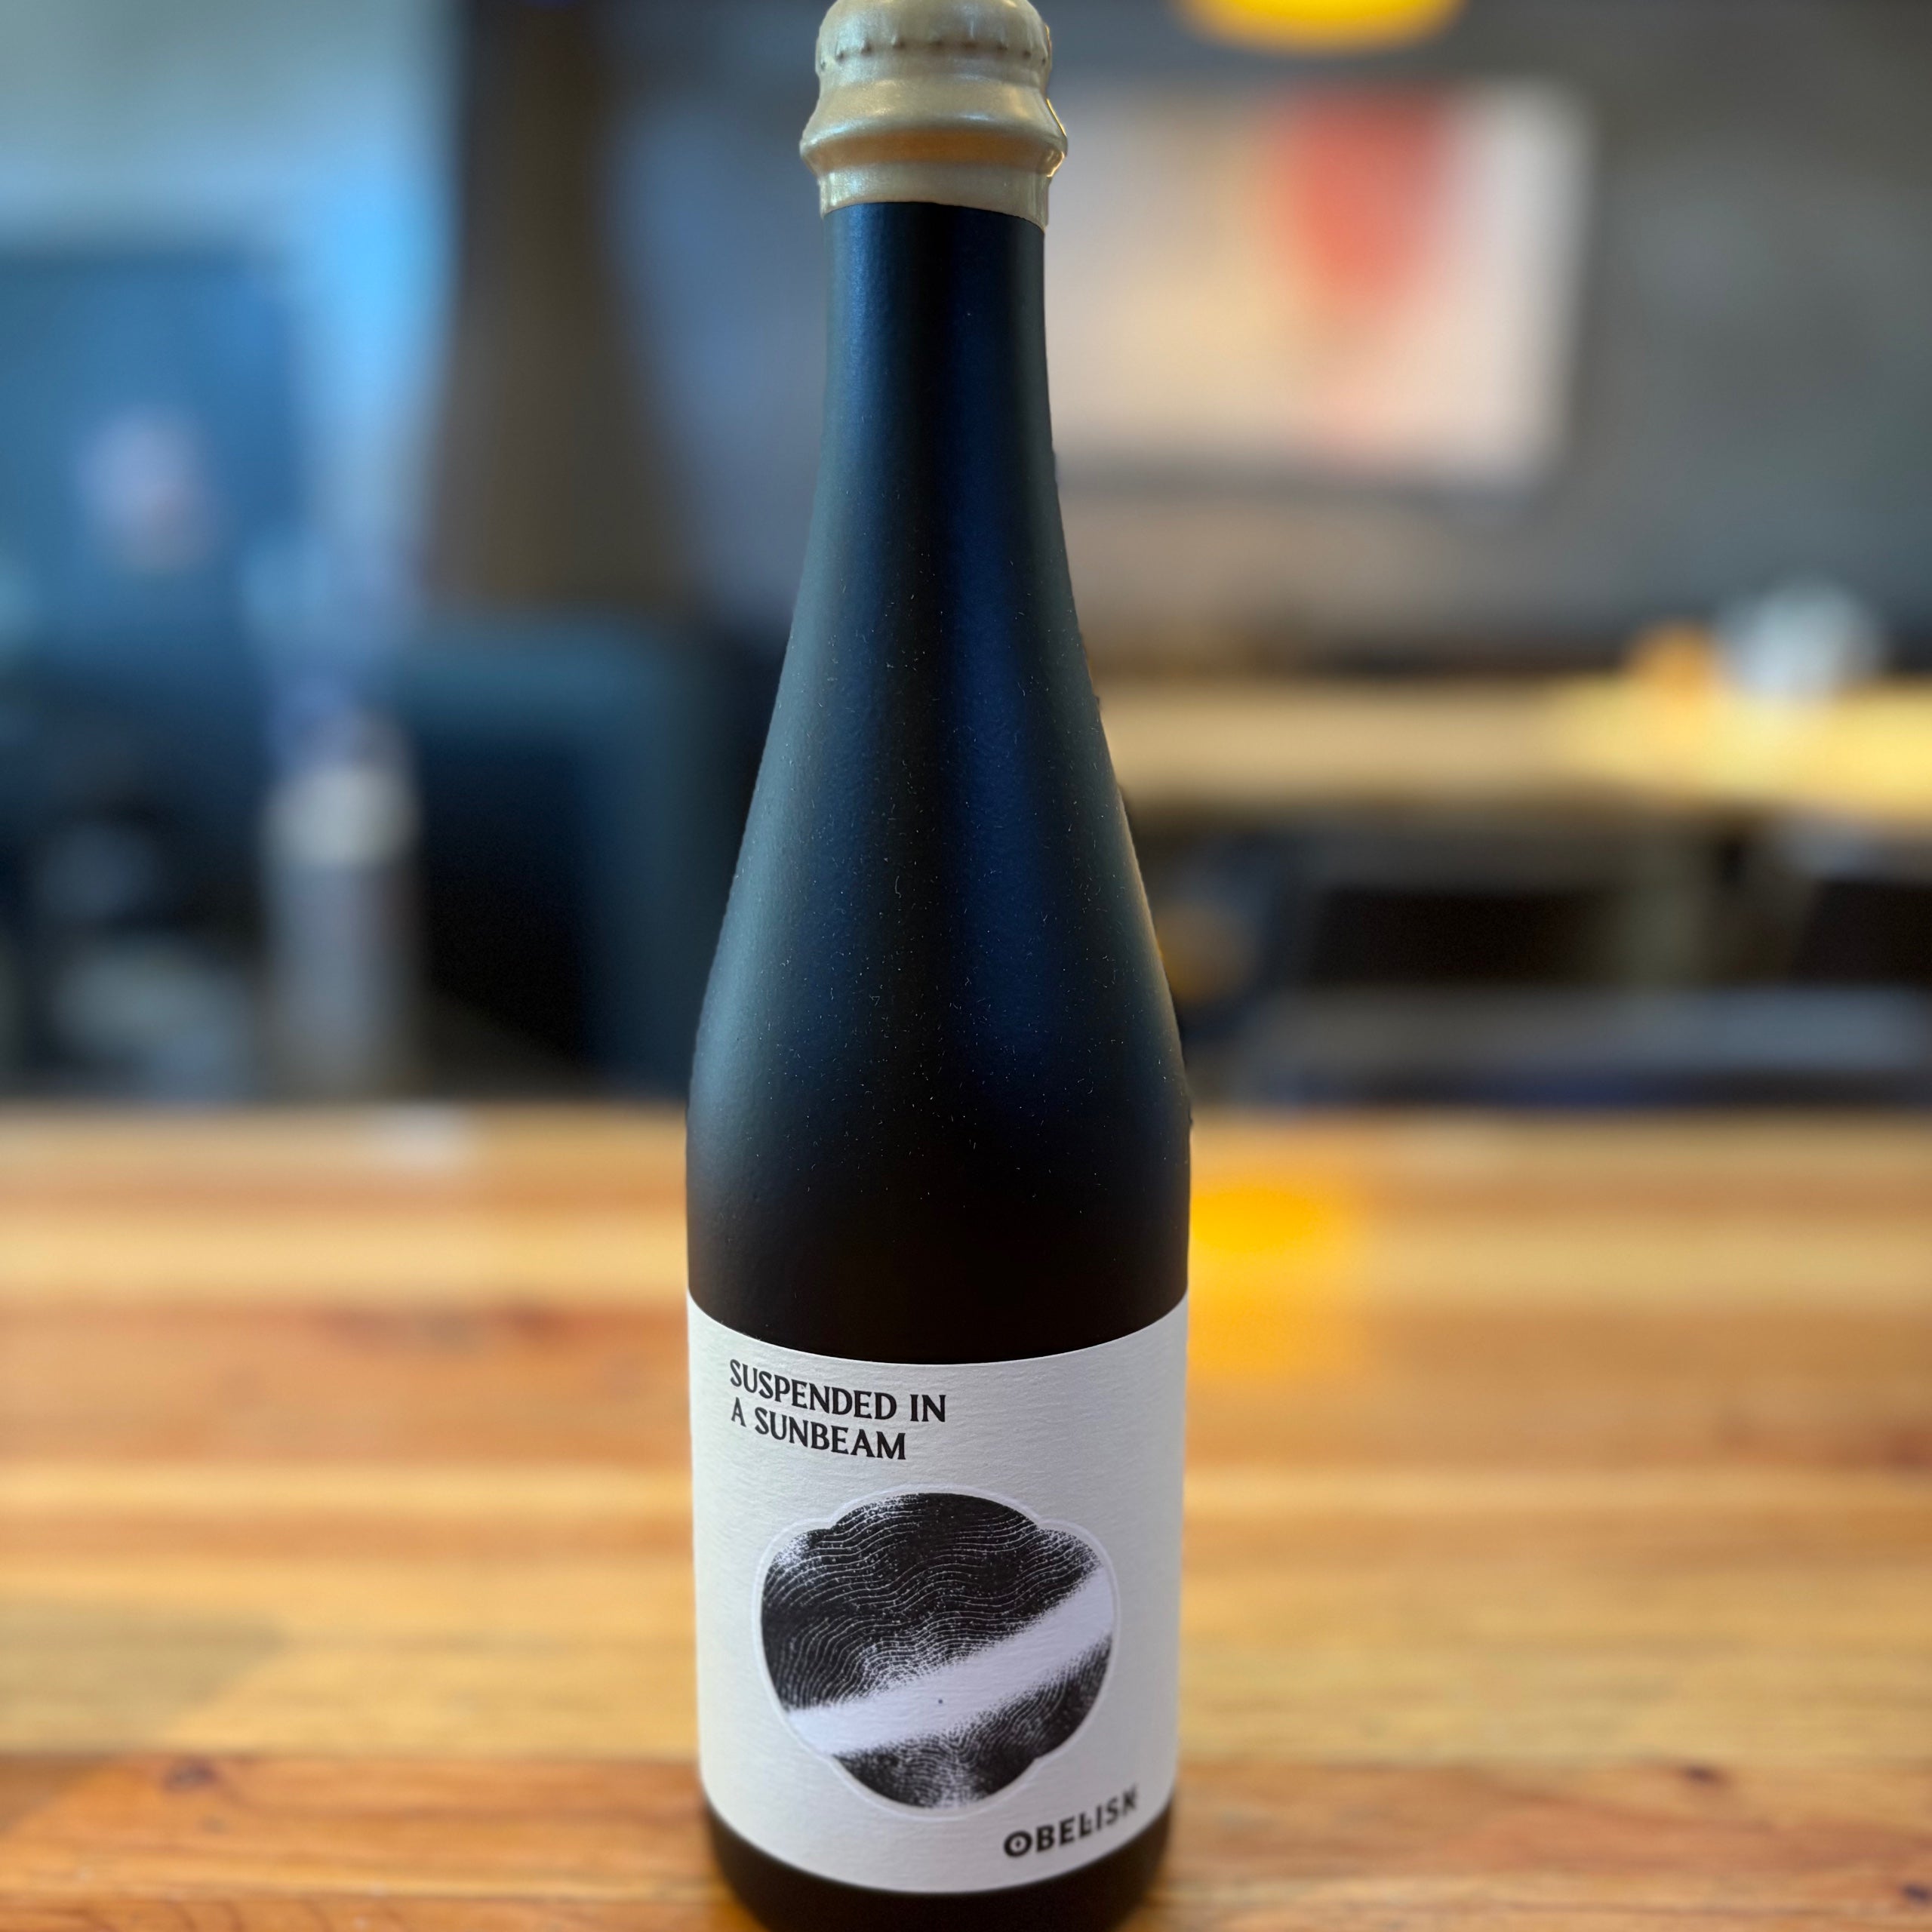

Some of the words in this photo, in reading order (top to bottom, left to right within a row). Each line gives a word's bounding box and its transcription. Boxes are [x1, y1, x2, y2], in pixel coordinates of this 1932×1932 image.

[730, 1358, 897, 1420] SUSPENDED
[909, 1394, 946, 1423] IN
[731, 1396, 747, 1428] A
[754, 1407, 906, 1460] SUNBEAM
[1003, 1784, 1137, 1858] OBELISK
